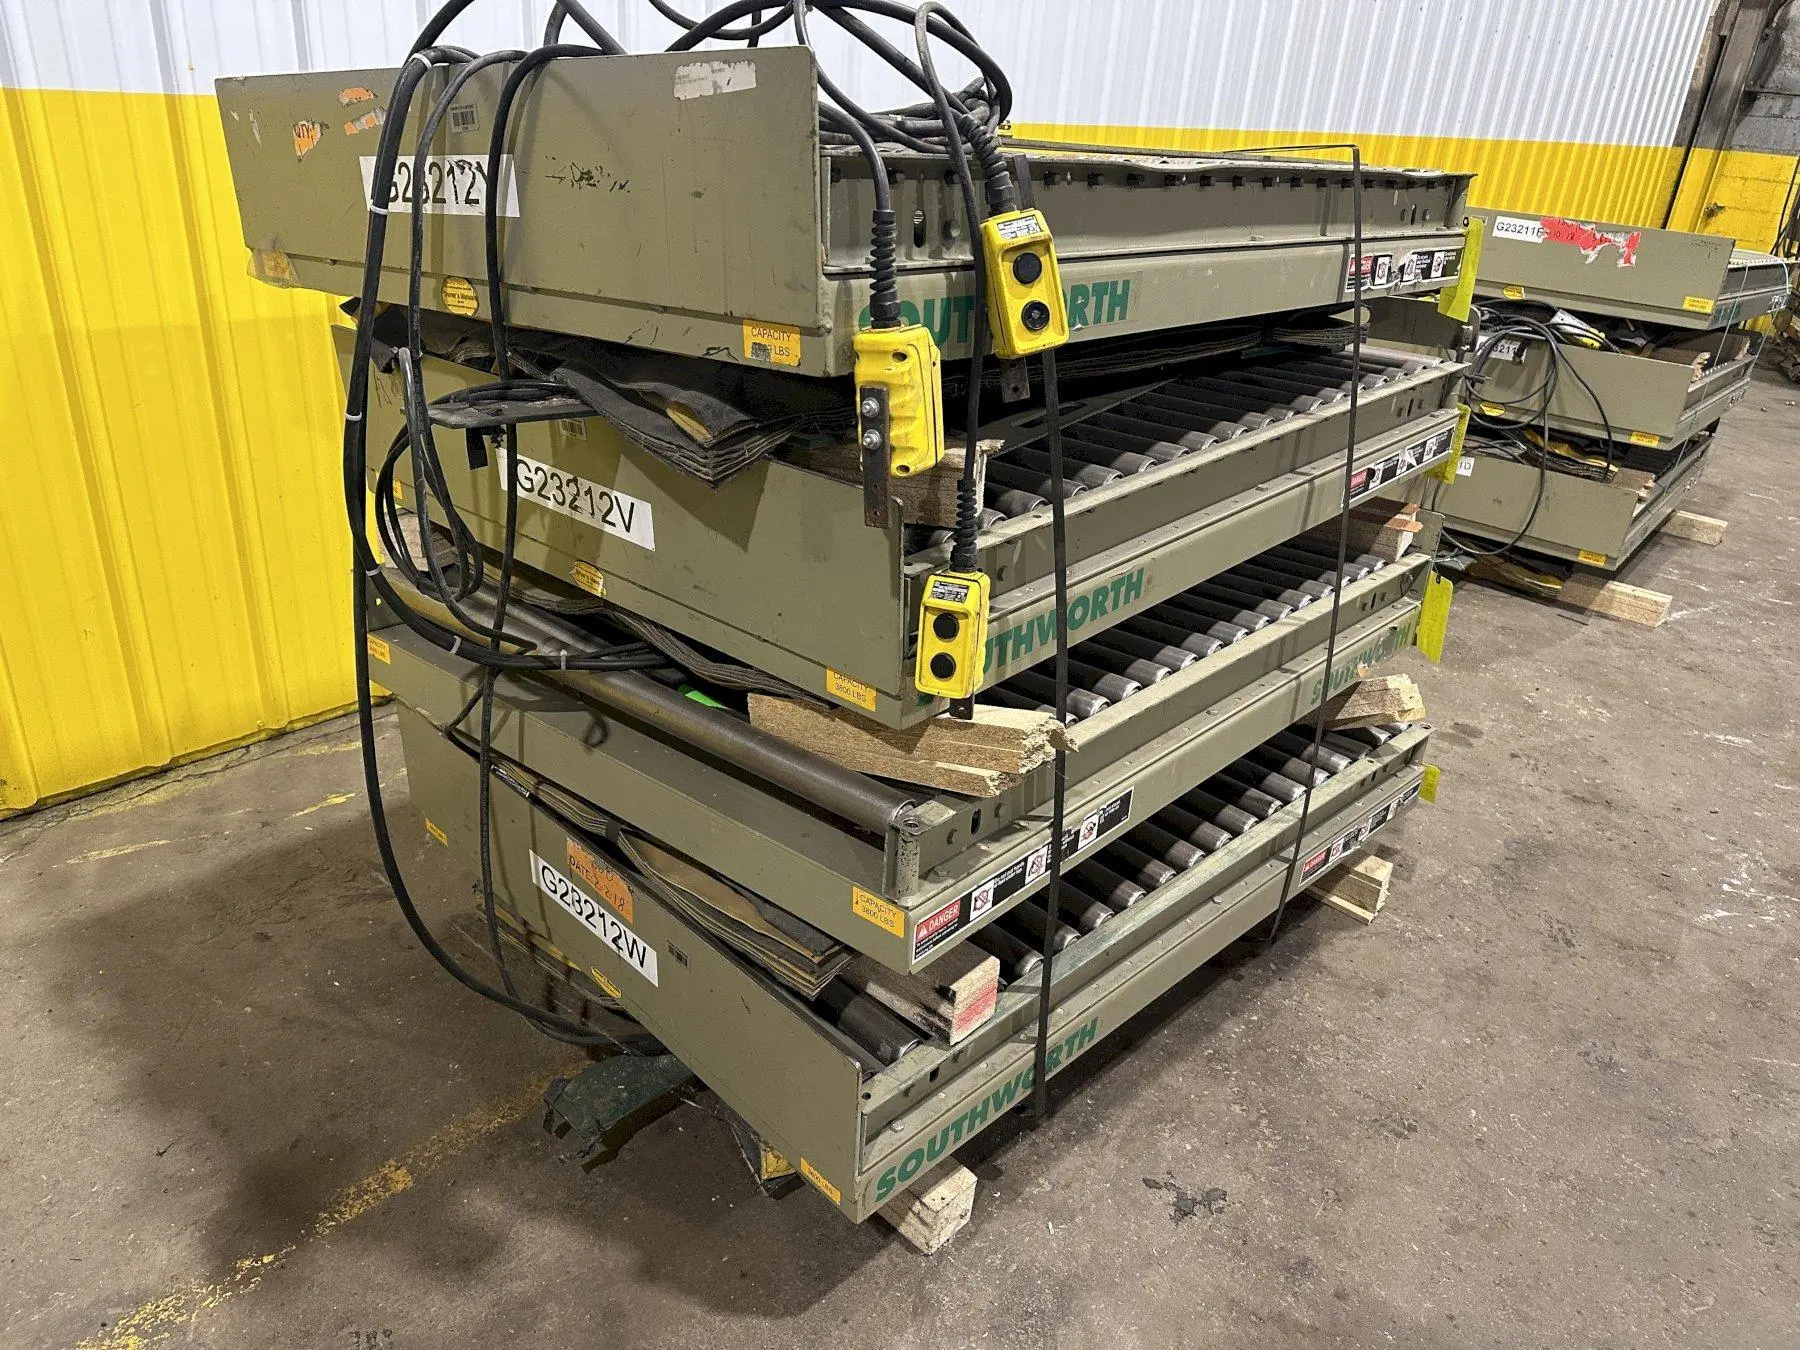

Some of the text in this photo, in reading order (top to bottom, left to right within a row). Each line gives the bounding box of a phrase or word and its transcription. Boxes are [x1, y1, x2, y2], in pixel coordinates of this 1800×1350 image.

[751, 327, 791, 342] CAPACITY
[774, 345, 790, 357] LBS
[517, 458, 635, 533] G23212V
[833, 671, 868, 692] CAPACITY
[853, 690, 867, 702] LBS
[860, 895, 897, 918] CAPACITY
[880, 915, 895, 928] LBS
[928, 904, 959, 931] DANGER
[874, 1017, 1098, 1203] SOUTHWORTH
